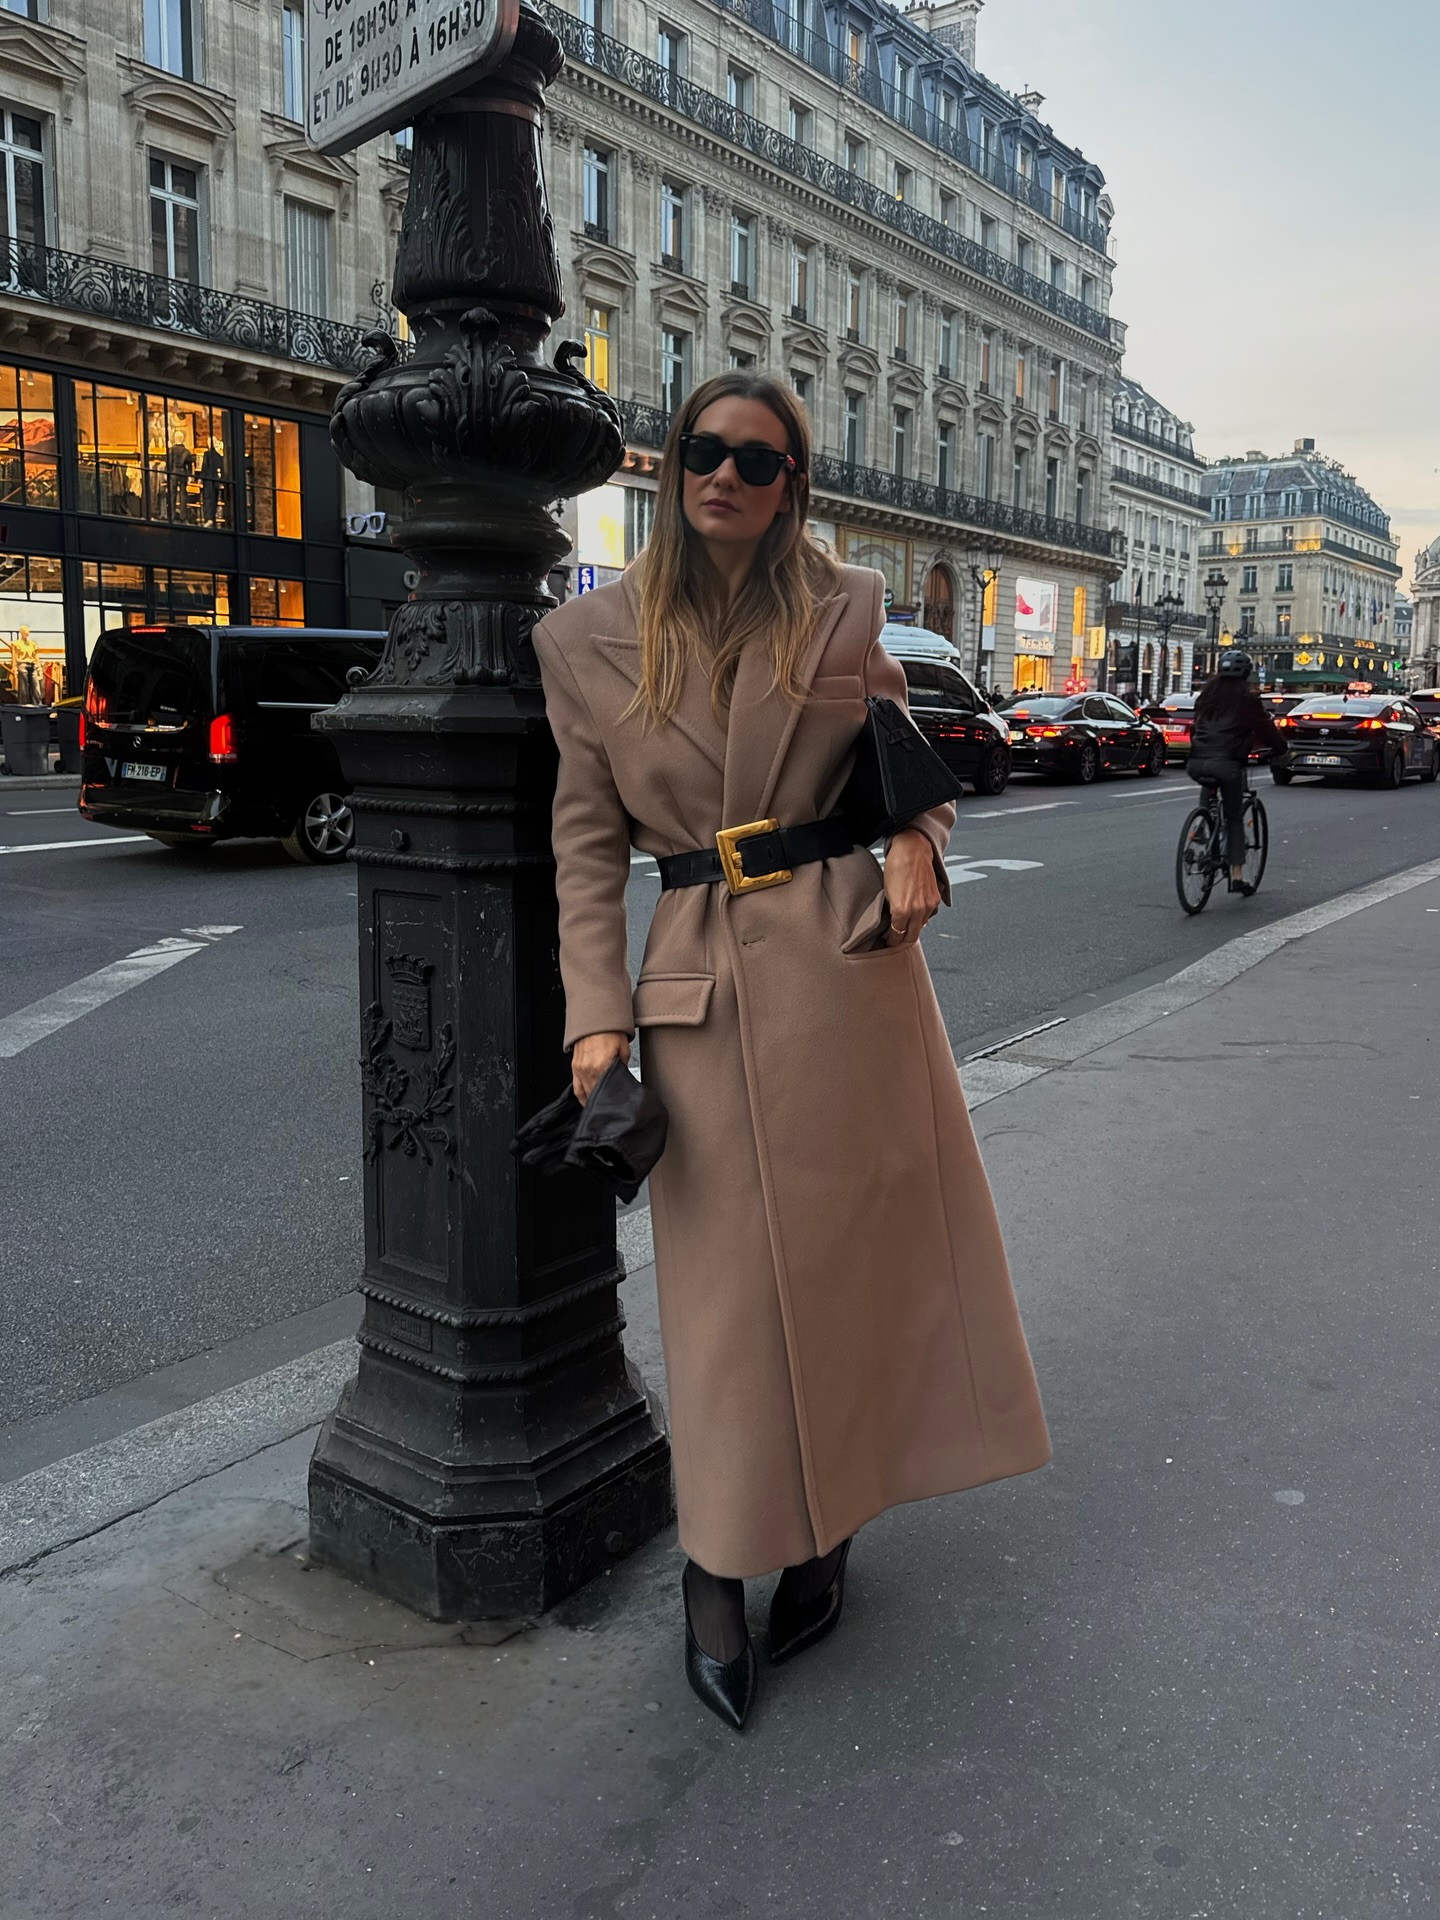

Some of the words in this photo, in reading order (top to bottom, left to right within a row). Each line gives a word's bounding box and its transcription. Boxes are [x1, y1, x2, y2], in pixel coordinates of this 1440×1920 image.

[313, 88, 330, 125] ET
[336, 72, 354, 112] DE
[360, 44, 402, 97] 9H30
[409, 26, 420, 69] À
[428, 0, 485, 56] 16H30
[325, 29, 343, 69] DE
[349, 0, 398, 53] 19H30
